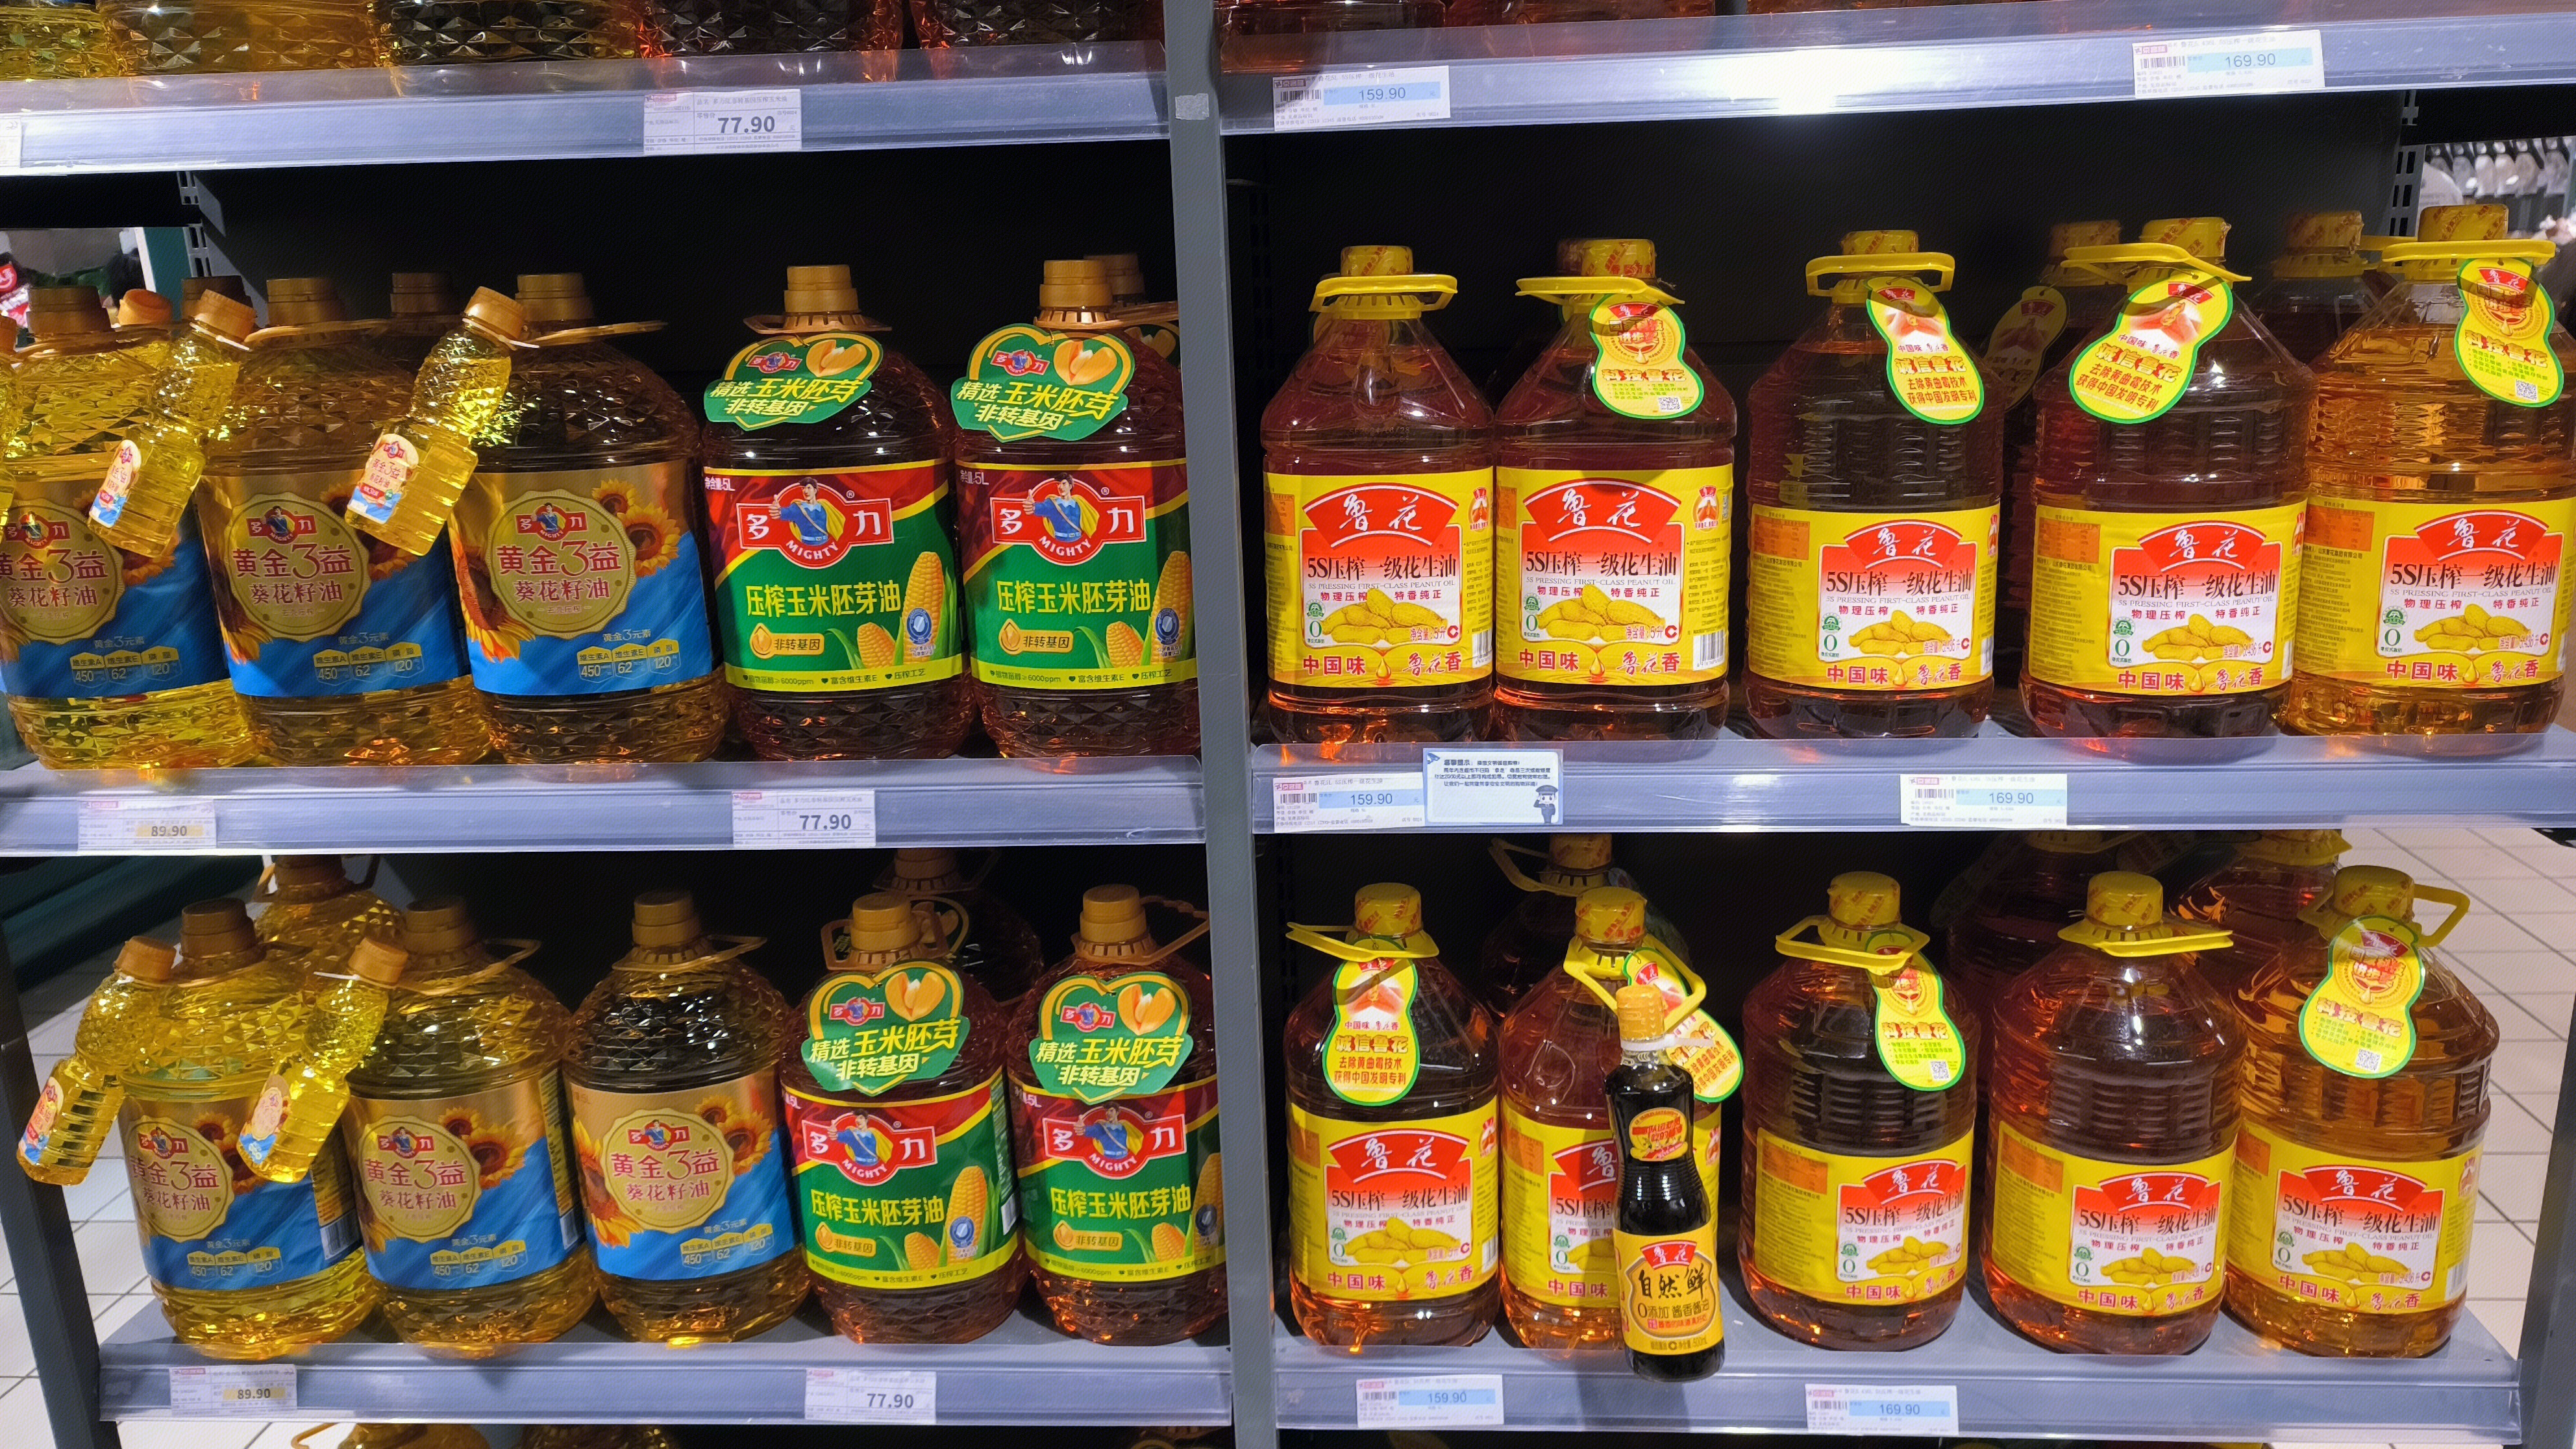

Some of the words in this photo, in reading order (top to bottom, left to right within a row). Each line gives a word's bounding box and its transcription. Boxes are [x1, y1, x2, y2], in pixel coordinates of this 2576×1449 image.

[2225, 53, 2276, 68] 169.90
[1359, 87, 1406, 101] 159.90
[718, 116, 775, 133] 77.90
[1894, 356, 1966, 375] 诚信鲁花
[2096, 343, 2182, 383] 诚信鲁花
[1908, 377, 1967, 390] 去除黄曲霉技术
[2089, 364, 2162, 393] 去除黄曲霉技术
[1908, 391, 1977, 404] 获得中国发明专利
[2076, 374, 2159, 412] 获得中国发明专利
[724, 398, 809, 416] 非转基因
[974, 403, 1065, 430] 非转基因
[1340, 493, 1422, 531] 鲁花
[1557, 488, 1642, 527] 鲁花
[1872, 528, 1937, 558] 鲁花
[2169, 528, 2238, 559] 鲁花
[2447, 518, 2521, 549] 鲁花
[786, 539, 839, 560] MIGHTY
[1039, 536, 1092, 557] MIGHTY
[232, 543, 354, 578] 黄金3益
[497, 540, 621, 576] 黄金3益
[1307, 554, 1456, 581] 5S压榨一级花生油
[1526, 552, 1677, 576] 5S压榨一级花生油
[1826, 569, 1972, 595] 5S压榨一级花生油
[2118, 571, 2277, 599] 5S压榨一级花生油
[2390, 560, 2557, 589] 5S压榨一级花生油
[7, 586, 97, 607] 葵花籽油
[251, 580, 343, 604] 葵花籽油
[514, 577, 610, 602] 葵花籽油
[746, 579, 902, 618] 压榨玉米胚芽油
[996, 578, 1152, 615] 压榨玉米胚芽油
[1320, 591, 1368, 602] 物理压榨
[1394, 589, 1443, 601] 特香纯正
[1537, 586, 1583, 597] 物理压榨
[1611, 588, 1660, 597] 特香纯正
[1839, 605, 1888, 615] 物理压榨
[1916, 604, 1959, 615] 特香纯正
[2132, 610, 2185, 620] 物理压榨
[2216, 606, 2261, 619] 特香纯正
[2404, 599, 2462, 610] 物理压榨
[2494, 597, 2540, 610] 特香纯正
[774, 638, 821, 651] 非转基因
[1023, 636, 1070, 649] 非转基因
[580, 665, 601, 677] 450
[618, 662, 632, 674] 62
[654, 656, 671, 669] 120
[1303, 654, 1365, 676] 中国味
[1402, 651, 1462, 676] 鲁花香
[1519, 649, 1579, 671] 中国味
[1616, 651, 1681, 675] 鲁花香
[2386, 660, 2458, 680] 中国味
[2484, 659, 2540, 683] 鲁花香
[894, 668, 926, 680] 压榨工艺
[1141, 669, 1172, 680] 压榨工艺
[1827, 665, 1889, 684] 中国味
[1912, 663, 1962, 685] 鲁花香
[2118, 671, 2185, 690] 中国味
[2209, 667, 2263, 692] 鲁花香
[1350, 793, 1393, 806] 159.90
[1989, 792, 2034, 804] 169.90
[151, 825, 188, 837] 89.90
[799, 814, 852, 830] 77.90
[1335, 1035, 1408, 1053] 诚信鲁花
[836, 1053, 919, 1081] 非转基因
[1339, 1056, 1402, 1070] 去除黄曲霉技术
[1058, 1065, 1141, 1086] 非转基因
[1334, 1071, 1406, 1085] 获得中国发明专利
[1089, 1152, 1138, 1172] MIGHTY
[1361, 1136, 1437, 1169] 鲁花
[130, 1156, 219, 1191] 黄金3益
[365, 1159, 467, 1189] 黄金3益
[611, 1149, 721, 1180] 黄金3益
[841, 1158, 888, 1179] MIGHTY
[1887, 1164, 1940, 1193] 鲁花
[2331, 1170, 2397, 1200] 鲁花
[143, 1187, 210, 1210] 葵花籽油
[380, 1189, 457, 1209] 葵花籽油
[626, 1180, 710, 1201] 葵花籽油
[2126, 1177, 2186, 1202] 鲁花
[810, 1189, 945, 1226] 压榨玉米胚芽油
[1050, 1183, 1191, 1220] 压榨玉米胚芽油
[2283, 1194, 2437, 1233] 5S压榨一级花生油
[834, 1237, 873, 1253] 非转基因
[1076, 1235, 1120, 1247] 非转基因
[1653, 1244, 1687, 1263] 鲁花
[1328, 1272, 1386, 1290] 中国味
[1548, 1279, 1609, 1298] 中国味
[1639, 1263, 1707, 1300] 自然鲜
[2279, 1275, 2340, 1303] 中国味
[1846, 1285, 1901, 1299] 中国味
[2078, 1289, 2138, 1309] 中国味
[1638, 1302, 1669, 1319] 0添加
[237, 1389, 271, 1399] 89.90
[867, 1393, 914, 1408] 77.90
[1428, 1392, 1467, 1404] 159.90
[1879, 1404, 1920, 1415] 169.90
